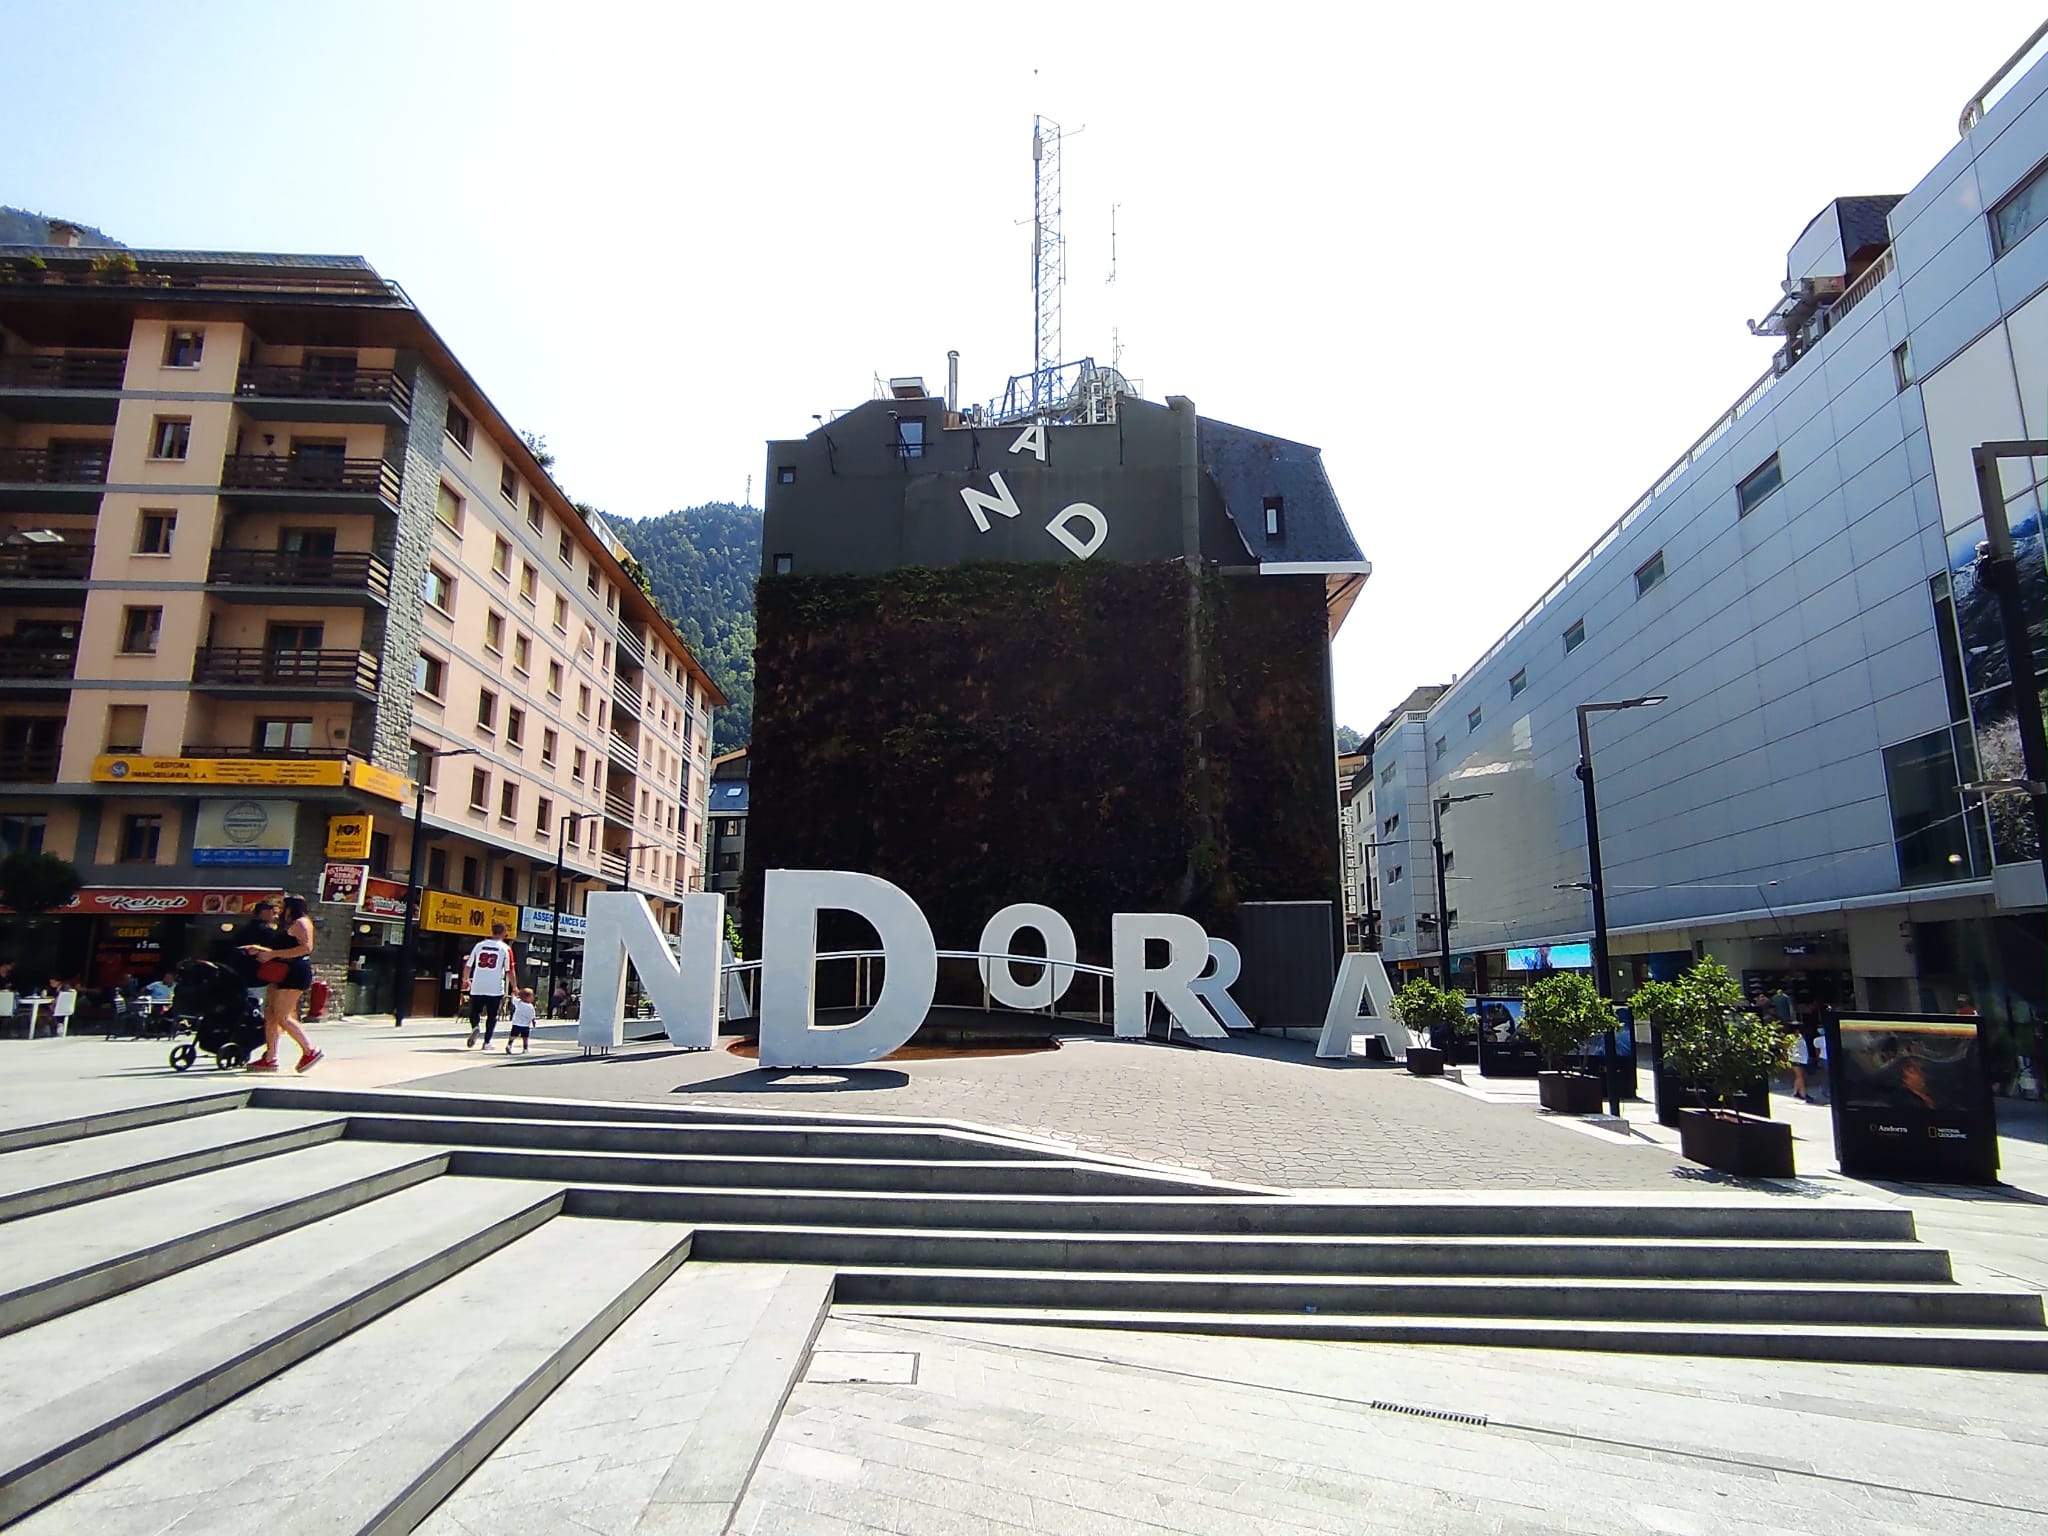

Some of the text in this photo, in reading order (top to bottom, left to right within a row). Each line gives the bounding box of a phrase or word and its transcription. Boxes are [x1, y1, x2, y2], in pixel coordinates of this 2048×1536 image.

[1008, 426, 1046, 462] A
[959, 471, 1022, 533] N
[1045, 502, 1108, 561] D
[153, 761, 191, 769] GESTORA
[95, 895, 189, 911] Kebab
[578, 890, 725, 1047] N
[759, 869, 937, 1068] D
[1112, 912, 1229, 1038] R
[1315, 951, 1414, 1059] A
[1878, 1124, 1908, 1134] Andorra
